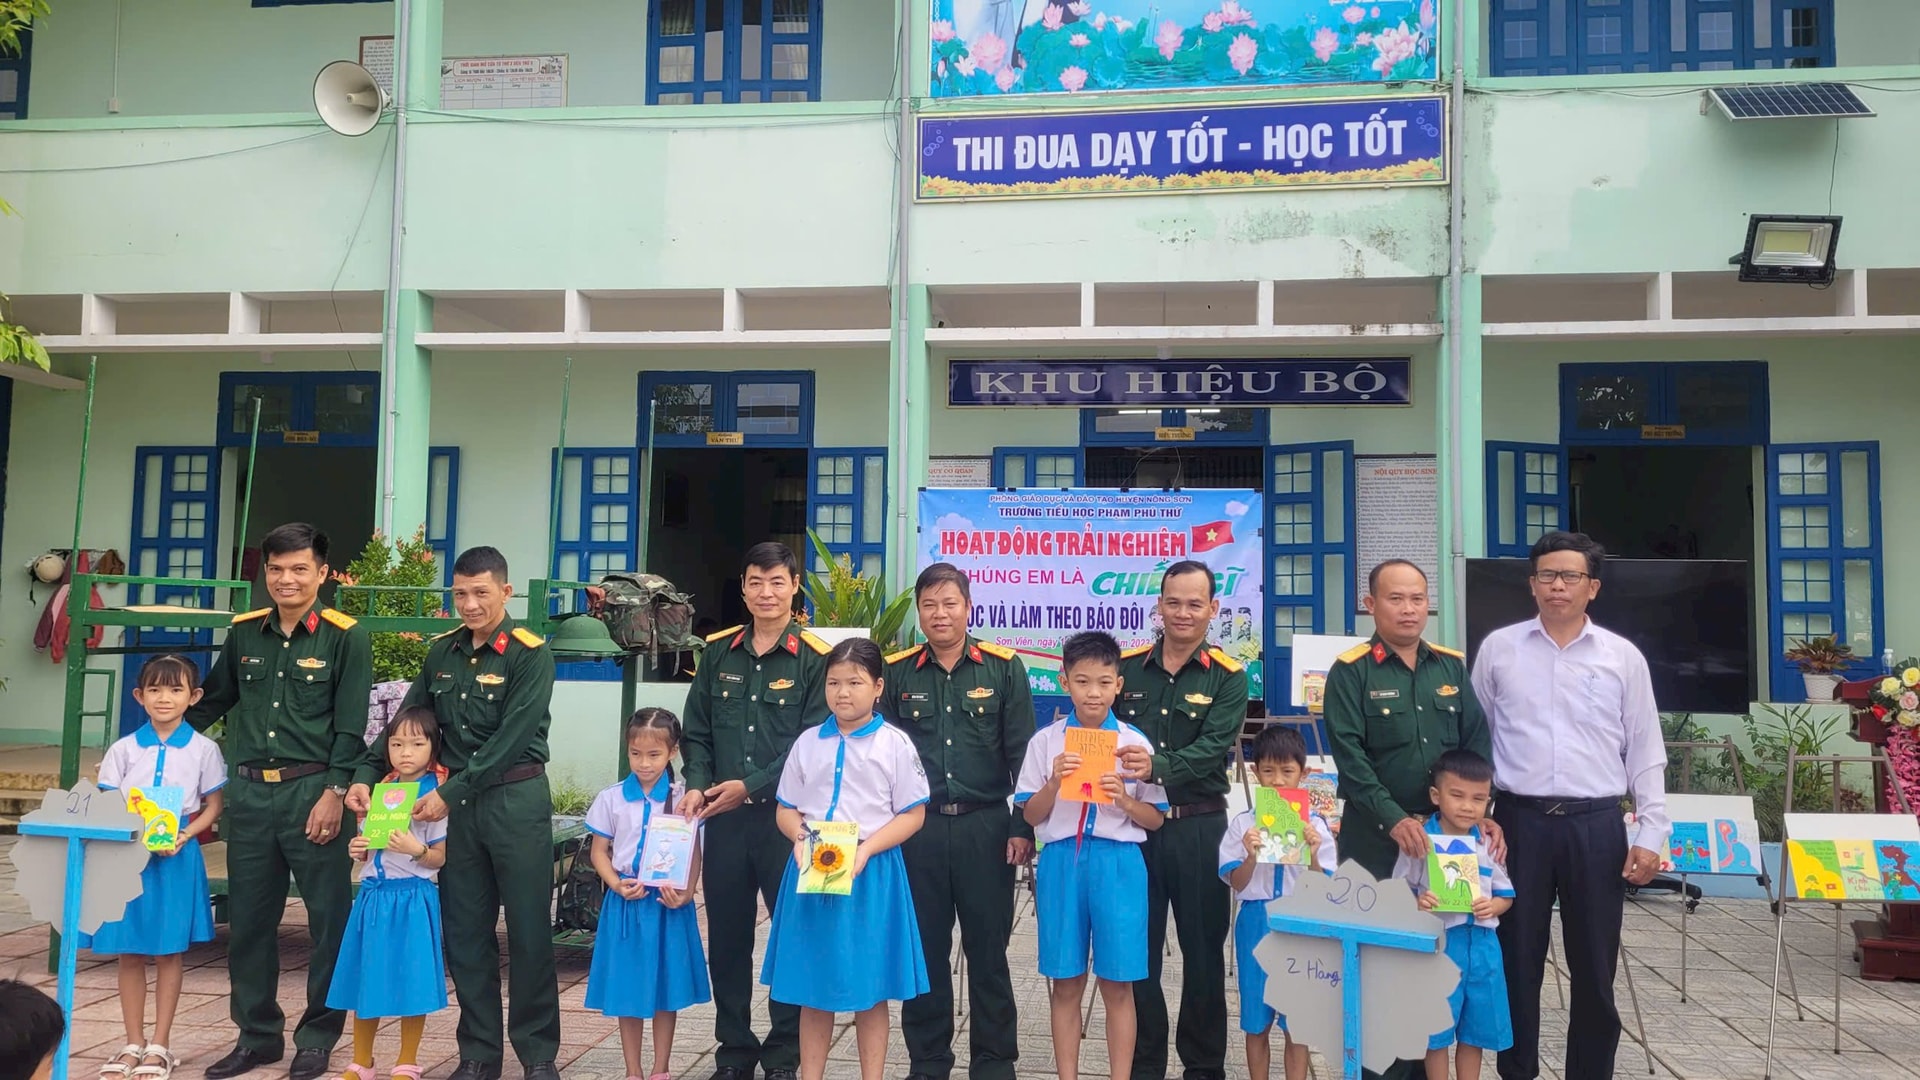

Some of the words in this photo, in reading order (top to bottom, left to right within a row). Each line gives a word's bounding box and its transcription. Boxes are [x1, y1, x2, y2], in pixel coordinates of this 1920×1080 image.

[953, 136, 1004, 171] THI
[1014, 134, 1080, 170] ĐUA
[1091, 130, 1157, 174] DẠY
[1167, 116, 1228, 164] TỐT
[1238, 142, 1251, 151] -
[1263, 123, 1333, 167] HỌC
[1344, 107, 1407, 157] TỐT
[975, 371, 1107, 395] KHU
[1125, 364, 1281, 400] HIỆU
[1300, 362, 1387, 400] BỘ
[990, 494, 1019, 502] PHÒNG
[1021, 493, 1042, 502] GIÁO
[1043, 495, 1062, 503] DỤC
[1063, 493, 1075, 503] VÀ
[1076, 493, 1095, 503] ĐÀO
[1116, 495, 1144, 504] HUYỆN
[1145, 494, 1171, 503] NÔNG
[1173, 495, 1192, 503] SƠN
[999, 506, 1042, 517] TRƯỜNG
[1045, 504, 1070, 517] TIỂU
[1072, 507, 1094, 518] HỌC
[1098, 507, 1130, 519] PHẠM
[1134, 505, 1156, 518] PHÚ
[1160, 506, 1182, 517] THỨ
[941, 531, 995, 560] HOẠT
[998, 526, 1052, 560] ĐỘNG
[1056, 522, 1103, 556] TRẢI
[1107, 527, 1186, 561] NGHIỆM
[1028, 569, 1054, 584] EM
[1061, 566, 1085, 585] LÀ
[1091, 560, 1170, 596] CHIẾ
[967, 604, 984, 633] ỌC
[989, 600, 1007, 628] VÀ
[1011, 600, 1042, 629] LÀM
[1046, 605, 1081, 630] THEO
[1087, 601, 1115, 630] BÁO
[1120, 602, 1144, 635] ĐỘI
[996, 637, 1012, 646] Sơn
[1037, 638, 1058, 648] ngày
[66, 791, 92, 817] 21
[1266, 799, 1288, 815] 22
[1277, 813, 1299, 829] 12
[1326, 876, 1377, 912] 20
[1286, 957, 1300, 974] 2
[1307, 958, 1341, 988] Hàng
